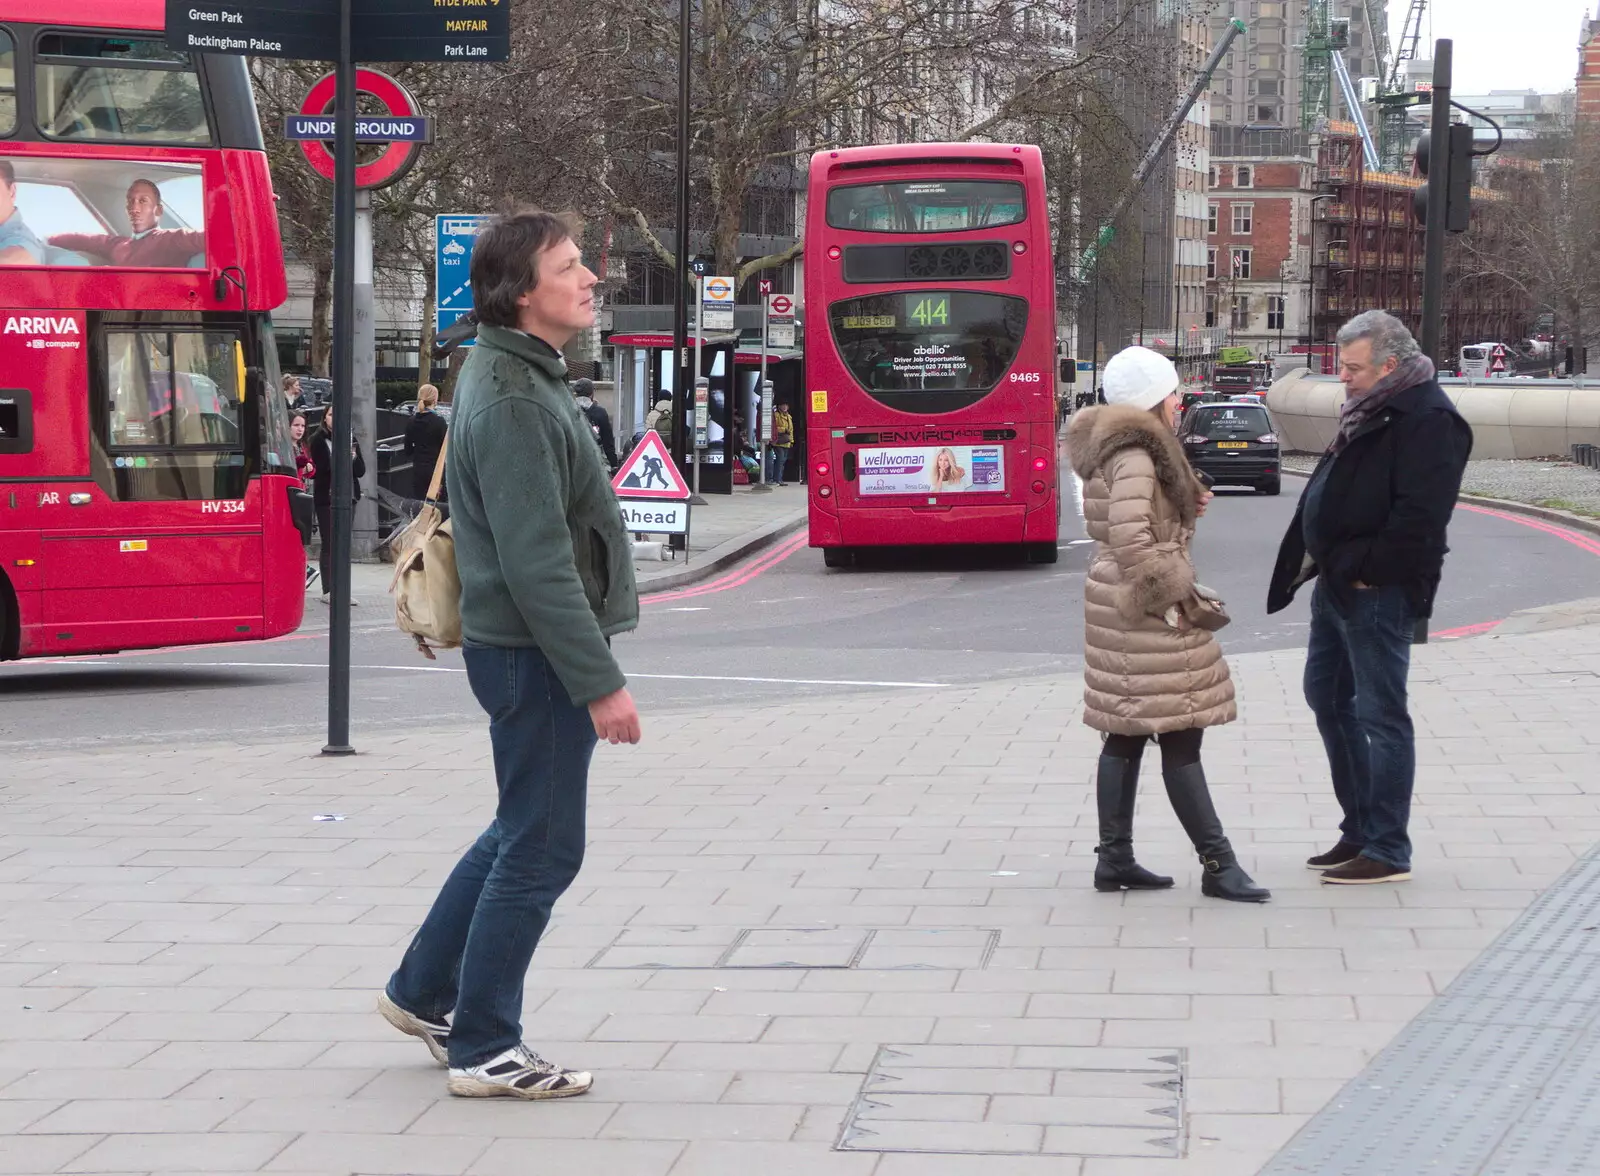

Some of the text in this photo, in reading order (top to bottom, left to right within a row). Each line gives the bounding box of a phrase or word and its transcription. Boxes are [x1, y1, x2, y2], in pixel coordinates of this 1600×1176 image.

[188, 8, 243, 23] Green Park
[446, 20, 488, 31] MAYFAIR
[188, 34, 282, 51] Buckingham Palace
[444, 44, 488, 56] Park Lane
[443, 257, 461, 266] taxi
[693, 263, 704, 272] 13
[760, 281, 771, 292] M
[911, 298, 948, 326] 414
[3, 316, 80, 334] ARRIVA
[45, 341, 80, 349] company
[913, 345, 945, 355] abellio
[1010, 372, 1040, 383] 9465
[864, 452, 925, 466] wellwoman
[41, 492, 60, 505] AR
[621, 508, 677, 524] Ahead
